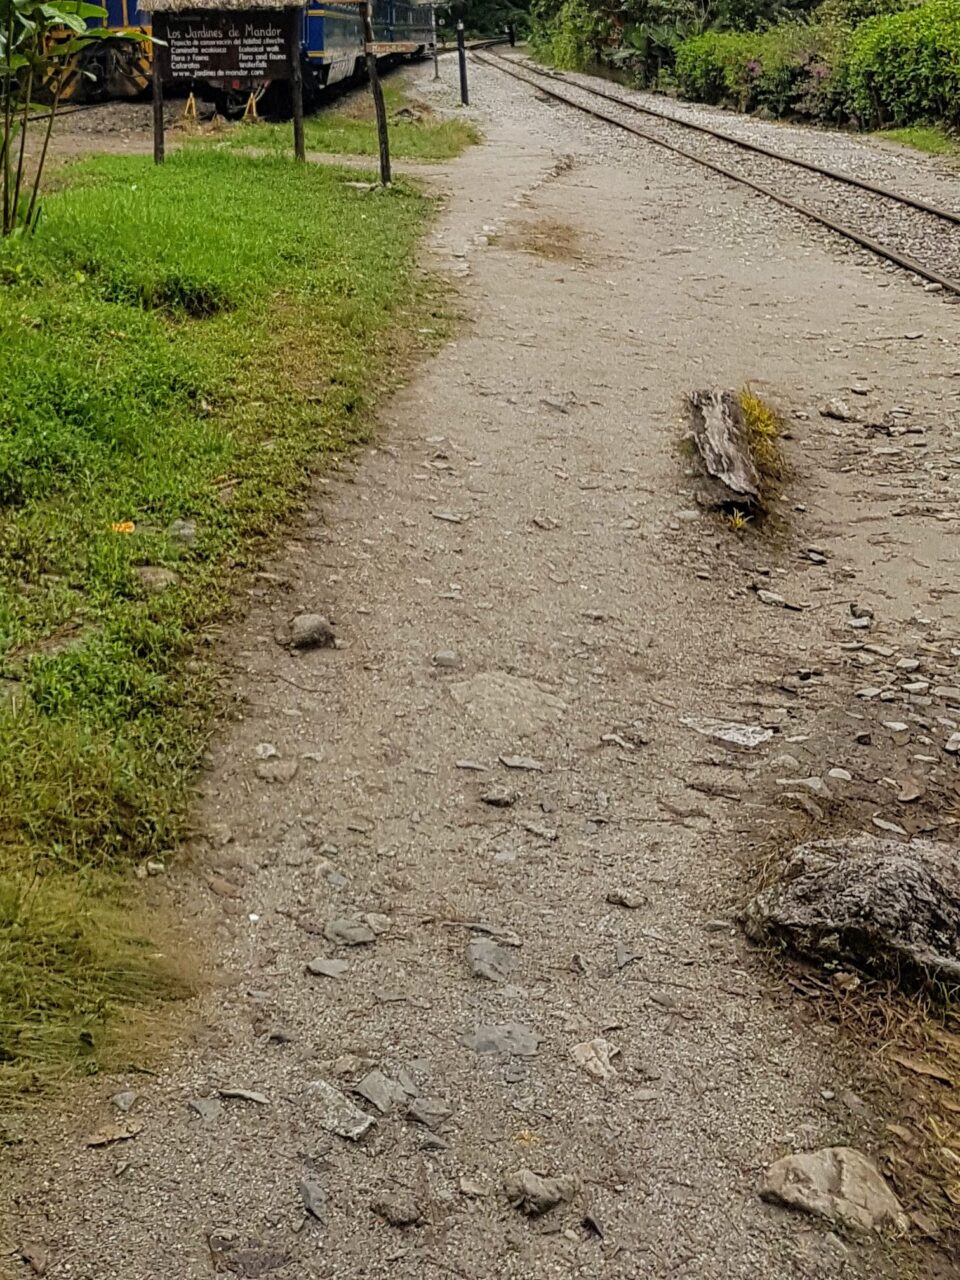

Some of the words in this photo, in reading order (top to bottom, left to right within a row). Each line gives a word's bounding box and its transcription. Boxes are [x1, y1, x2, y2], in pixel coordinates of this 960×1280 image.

[167, 25, 181, 39] Los
[185, 24, 223, 38] Jardines
[228, 24, 240, 37] de
[245, 23, 282, 37] Mandor
